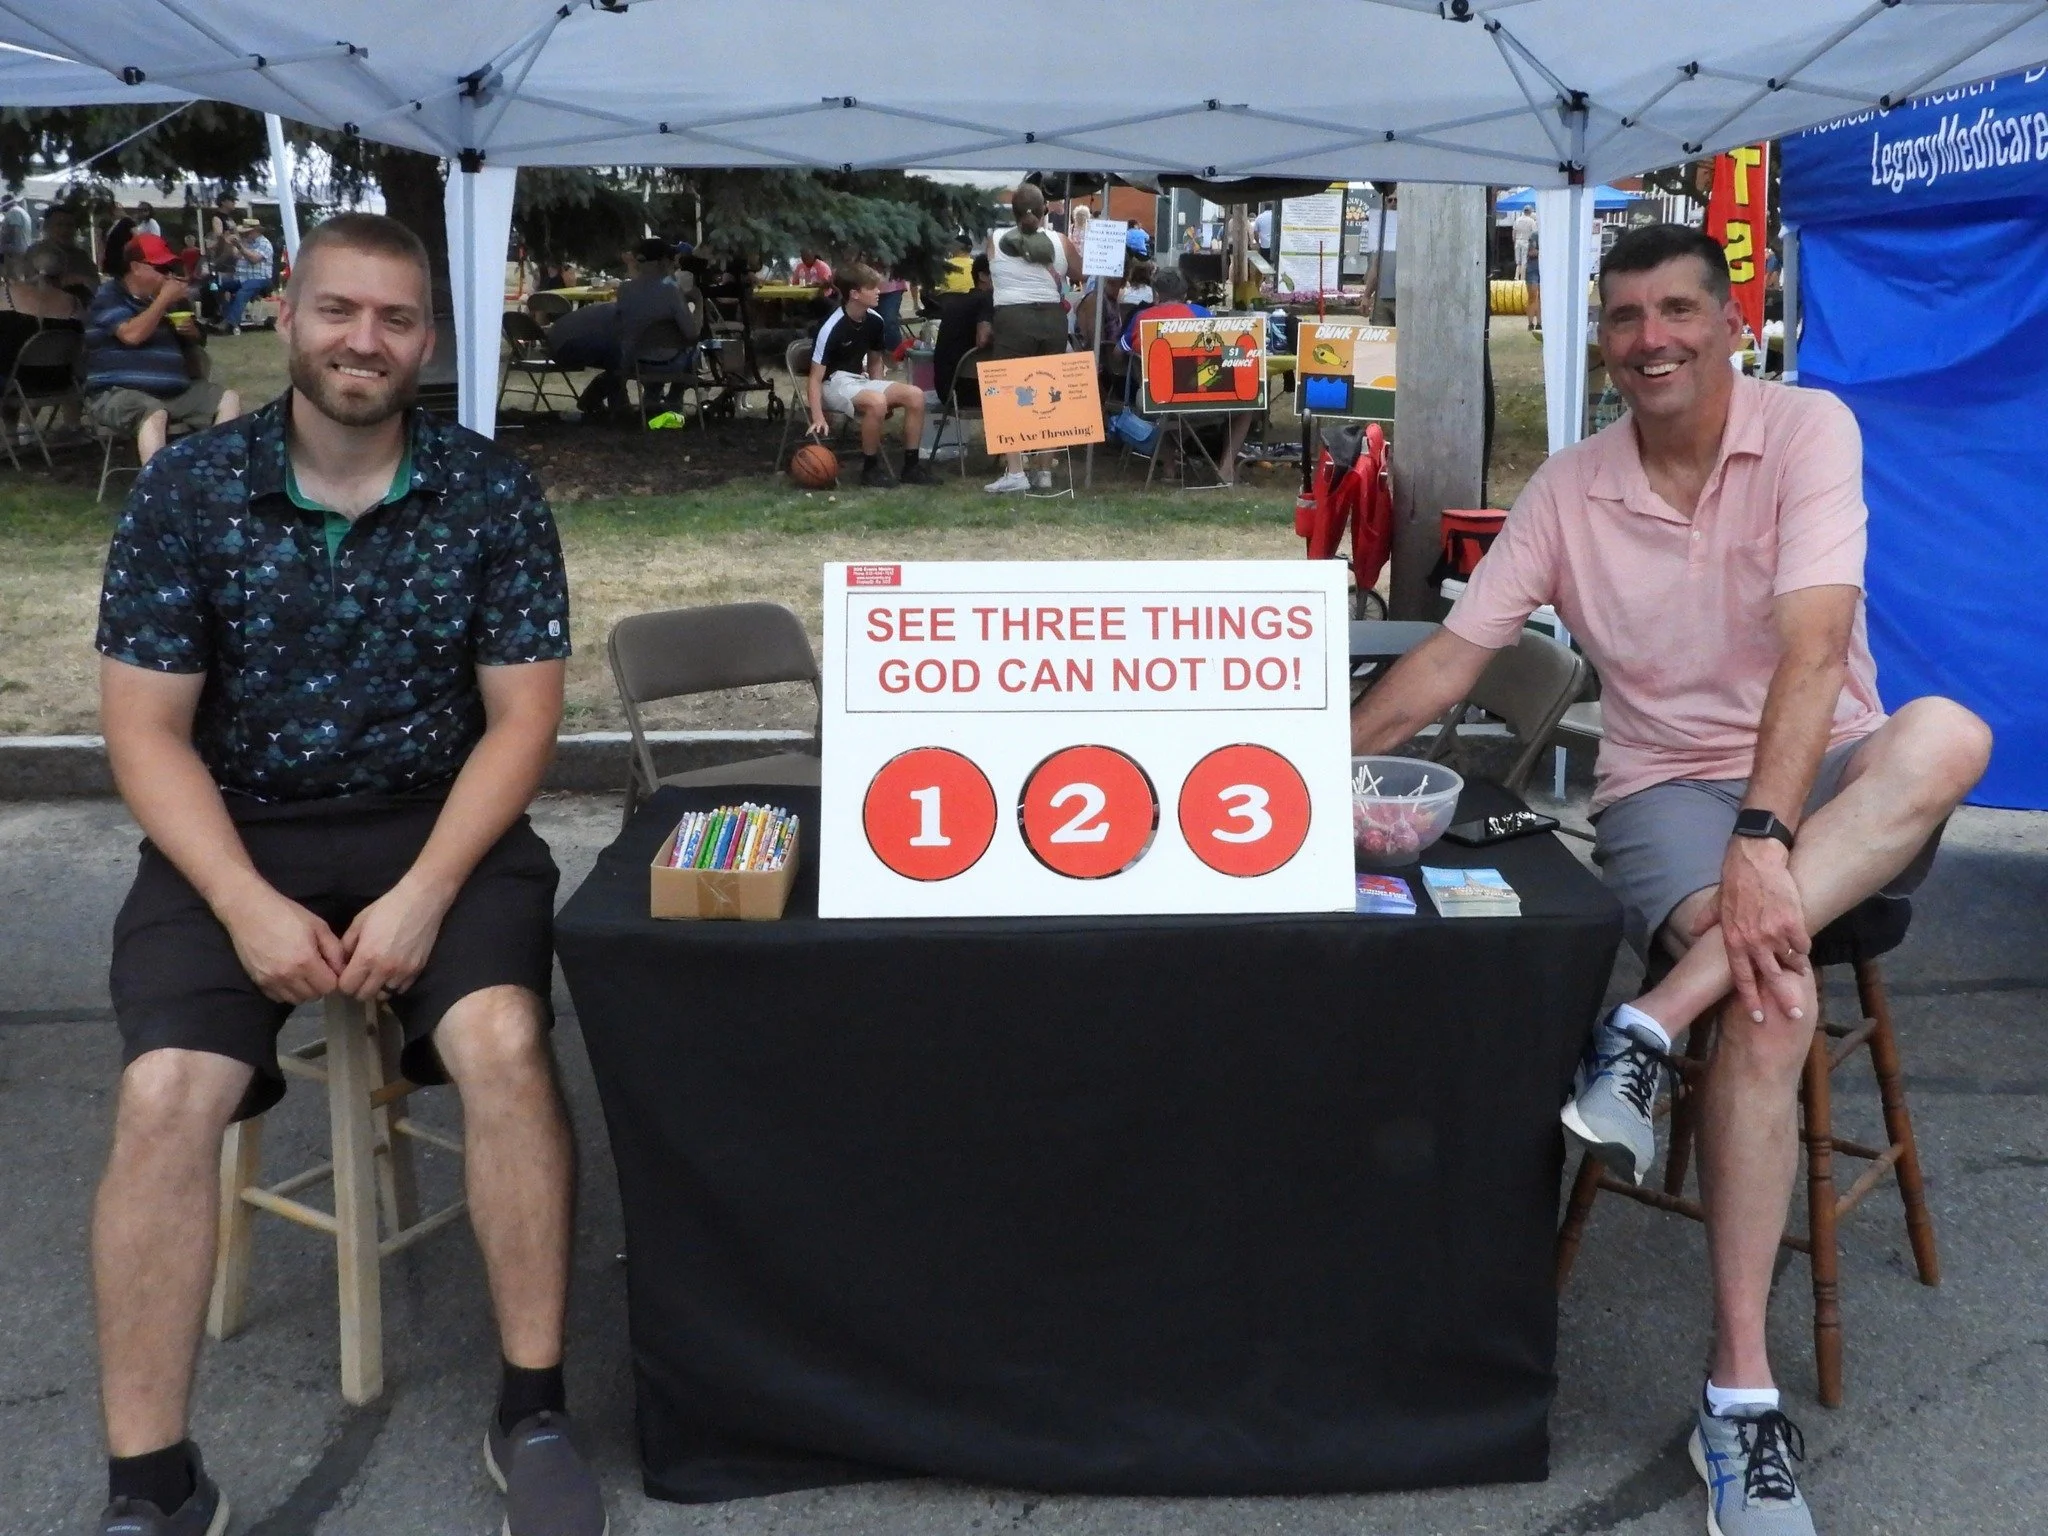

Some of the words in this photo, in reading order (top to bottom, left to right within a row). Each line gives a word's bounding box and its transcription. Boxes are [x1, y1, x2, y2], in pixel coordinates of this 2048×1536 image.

[1161, 320, 1208, 333] BOUNCE
[1213, 319, 1255, 332] HOUSE
[1315, 324, 1354, 340] DUNK
[1356, 326, 1390, 341] TANK
[1228, 347, 1239, 356] $1
[1246, 348, 1263, 358] PER
[1221, 358, 1254, 368] BOUNCE
[996, 435, 1016, 446] Try
[1019, 432, 1038, 442] Axe
[1040, 424, 1095, 440] Throwing!
[867, 608, 954, 642] SEE
[974, 607, 1126, 640] THREE
[1144, 607, 1313, 639] THINGS
[878, 659, 980, 693] GOD
[998, 659, 1094, 693] CAN
[1113, 658, 1207, 691] NOT
[1223, 657, 1304, 691] DO!
[909, 785, 952, 847] 1
[1049, 782, 1111, 844] 2
[1210, 783, 1274, 844] 3
